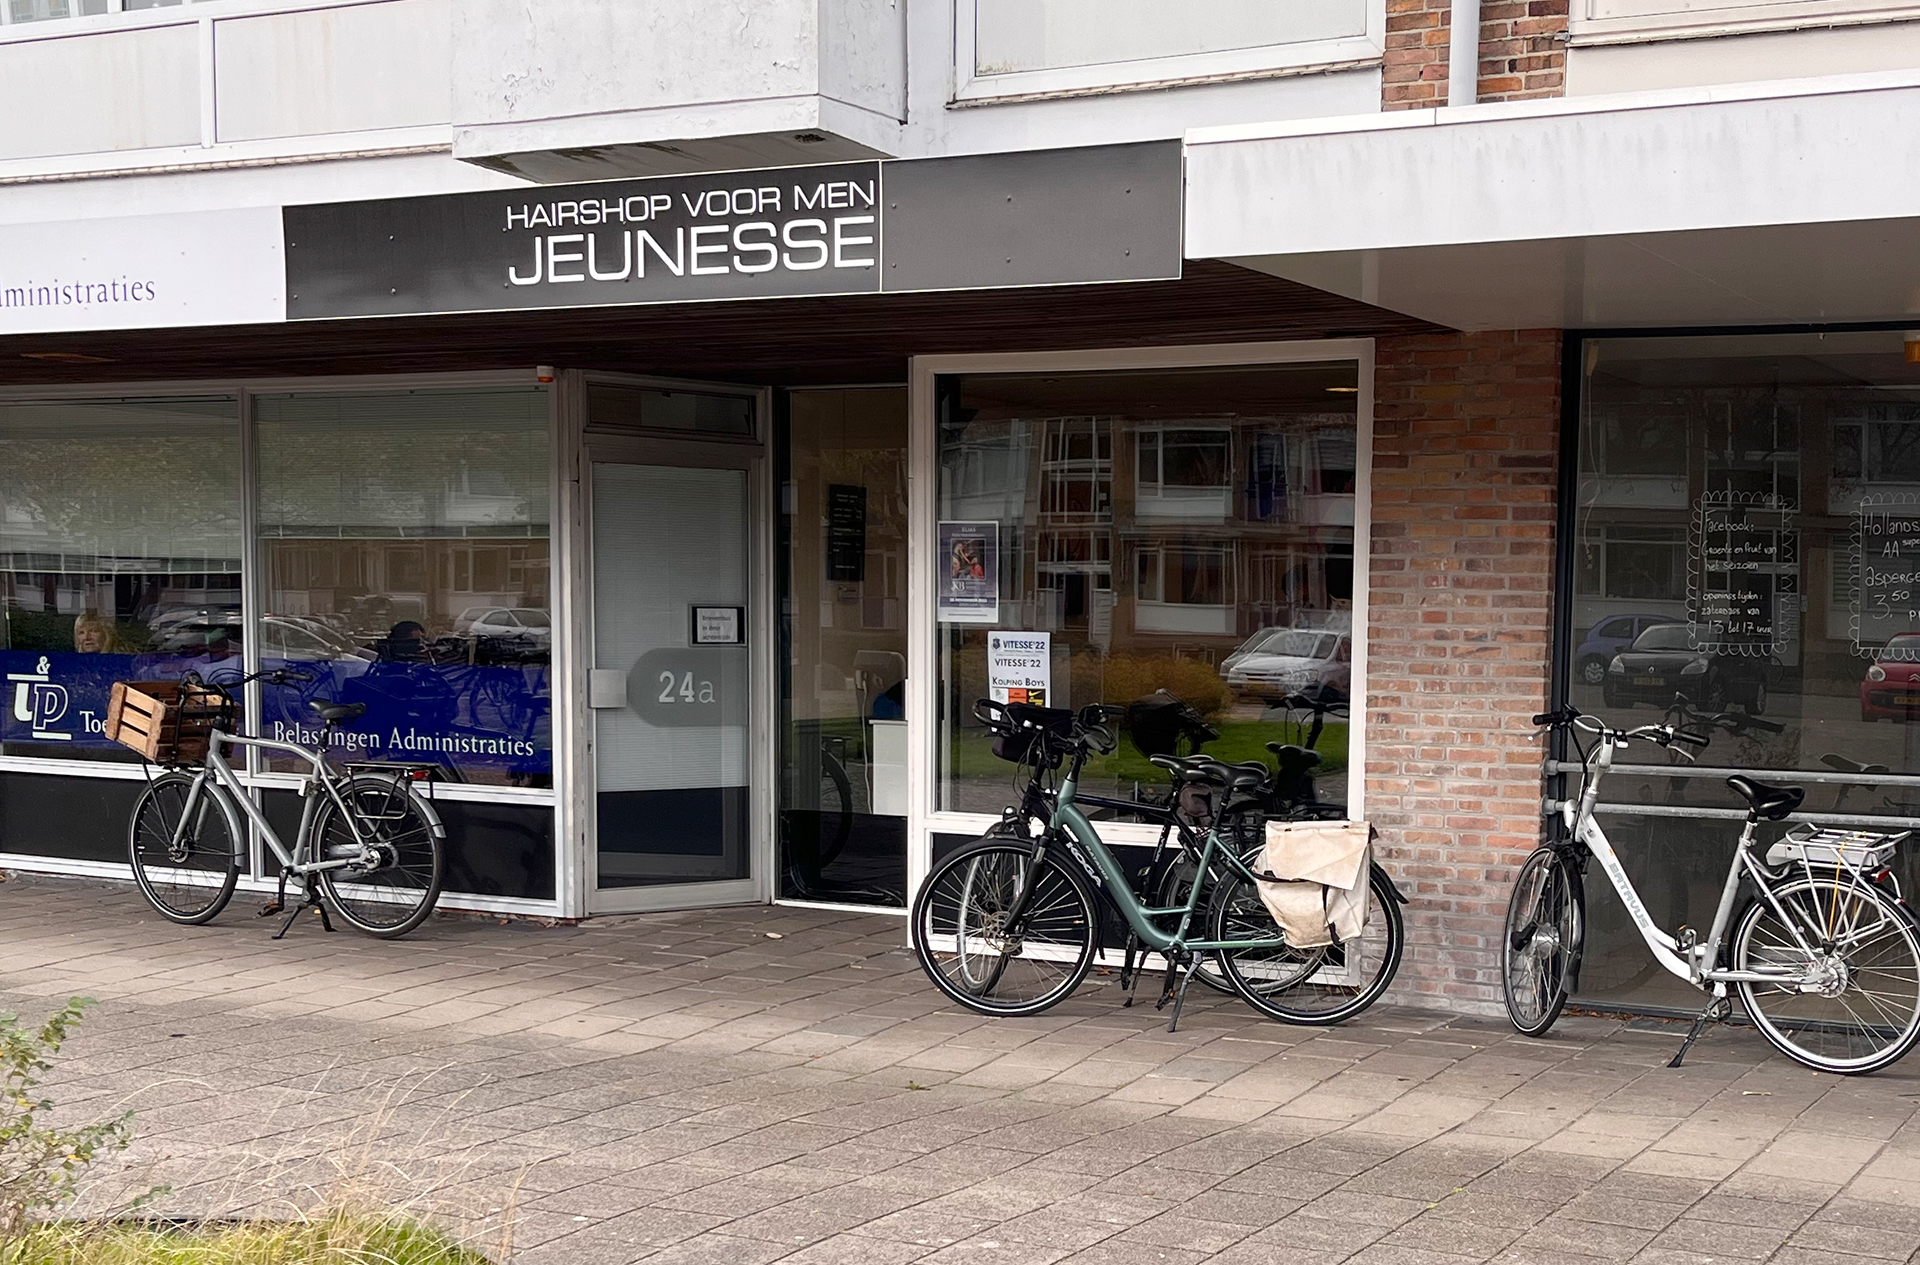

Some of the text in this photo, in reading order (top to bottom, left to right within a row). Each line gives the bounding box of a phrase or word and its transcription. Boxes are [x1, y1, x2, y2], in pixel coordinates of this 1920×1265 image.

[506, 180, 874, 230] HAIRSHOP VOOR MEN
[508, 215, 875, 286] JEUNESSE
[0, 275, 156, 307] ministraties
[1881, 540, 1900, 559] AA
[36, 655, 51, 675] &
[658, 670, 716, 704] 24a
[388, 727, 535, 757] Administraties
[1065, 841, 1102, 888] KOGA
[1608, 862, 1650, 929] BATAVUS
